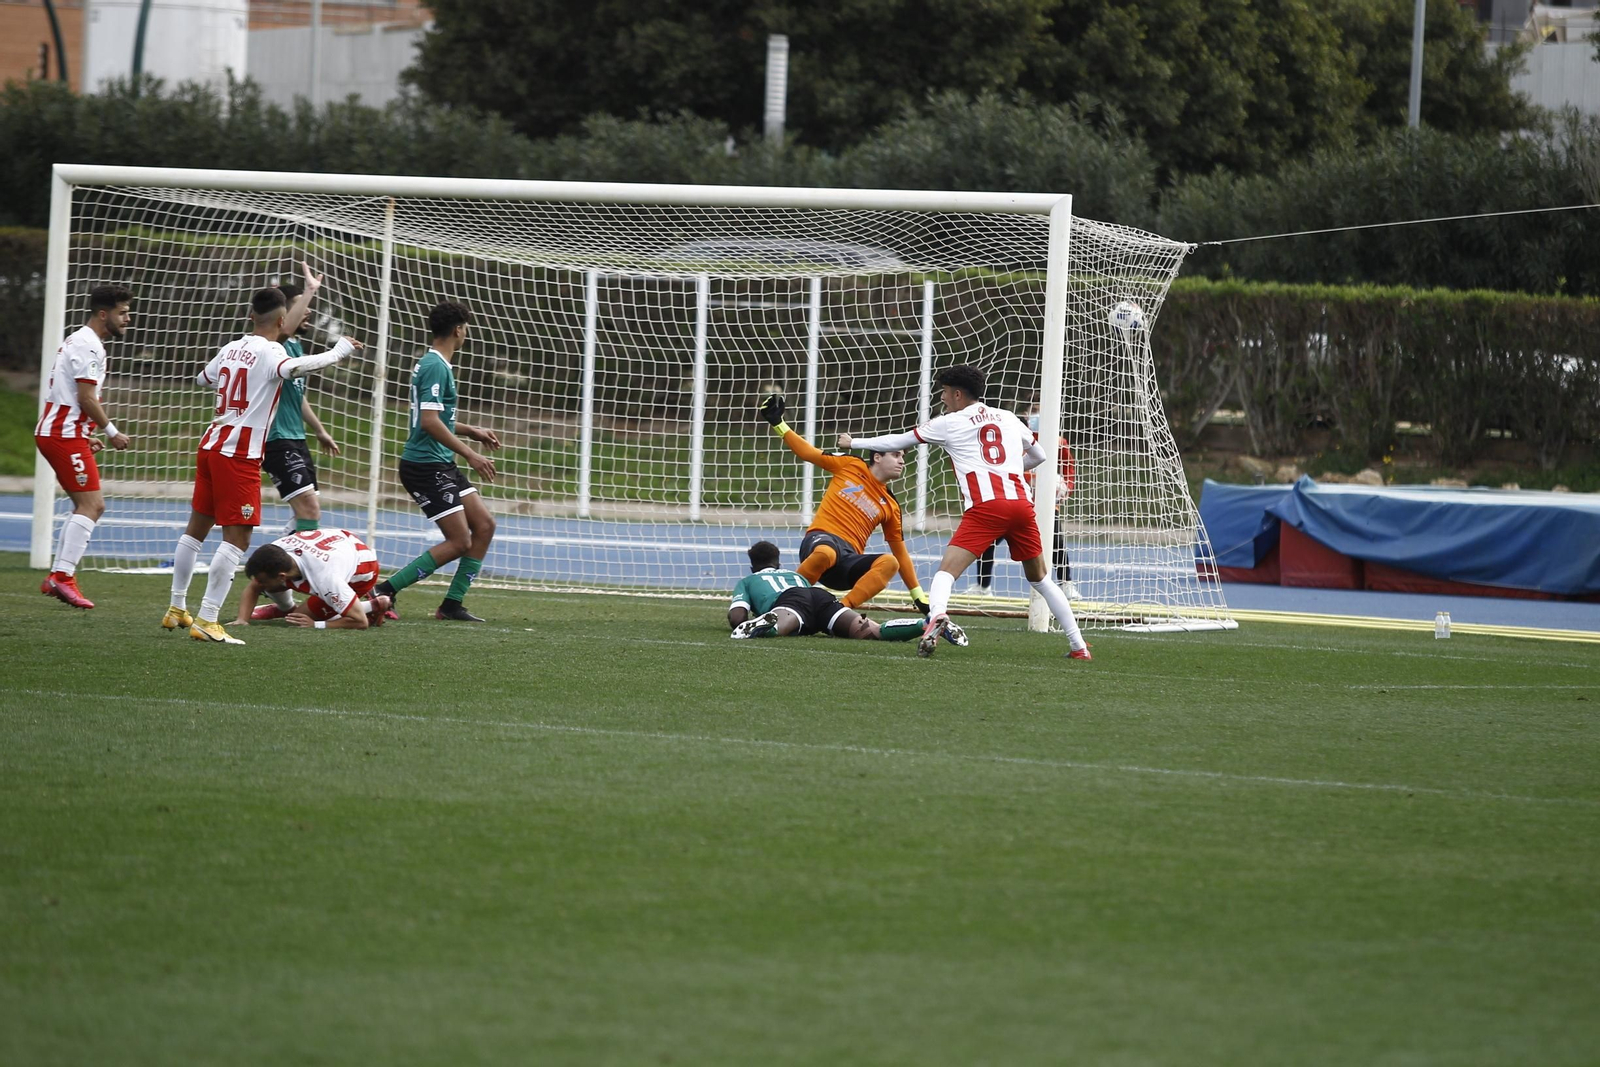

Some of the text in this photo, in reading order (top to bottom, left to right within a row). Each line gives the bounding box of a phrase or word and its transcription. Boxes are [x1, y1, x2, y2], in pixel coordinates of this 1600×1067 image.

[215, 366, 250, 417] 34
[969, 413, 1002, 425] TOMAS
[978, 424, 1006, 465] 8
[70, 453, 85, 472] 5
[282, 536, 330, 562] CABALLER
